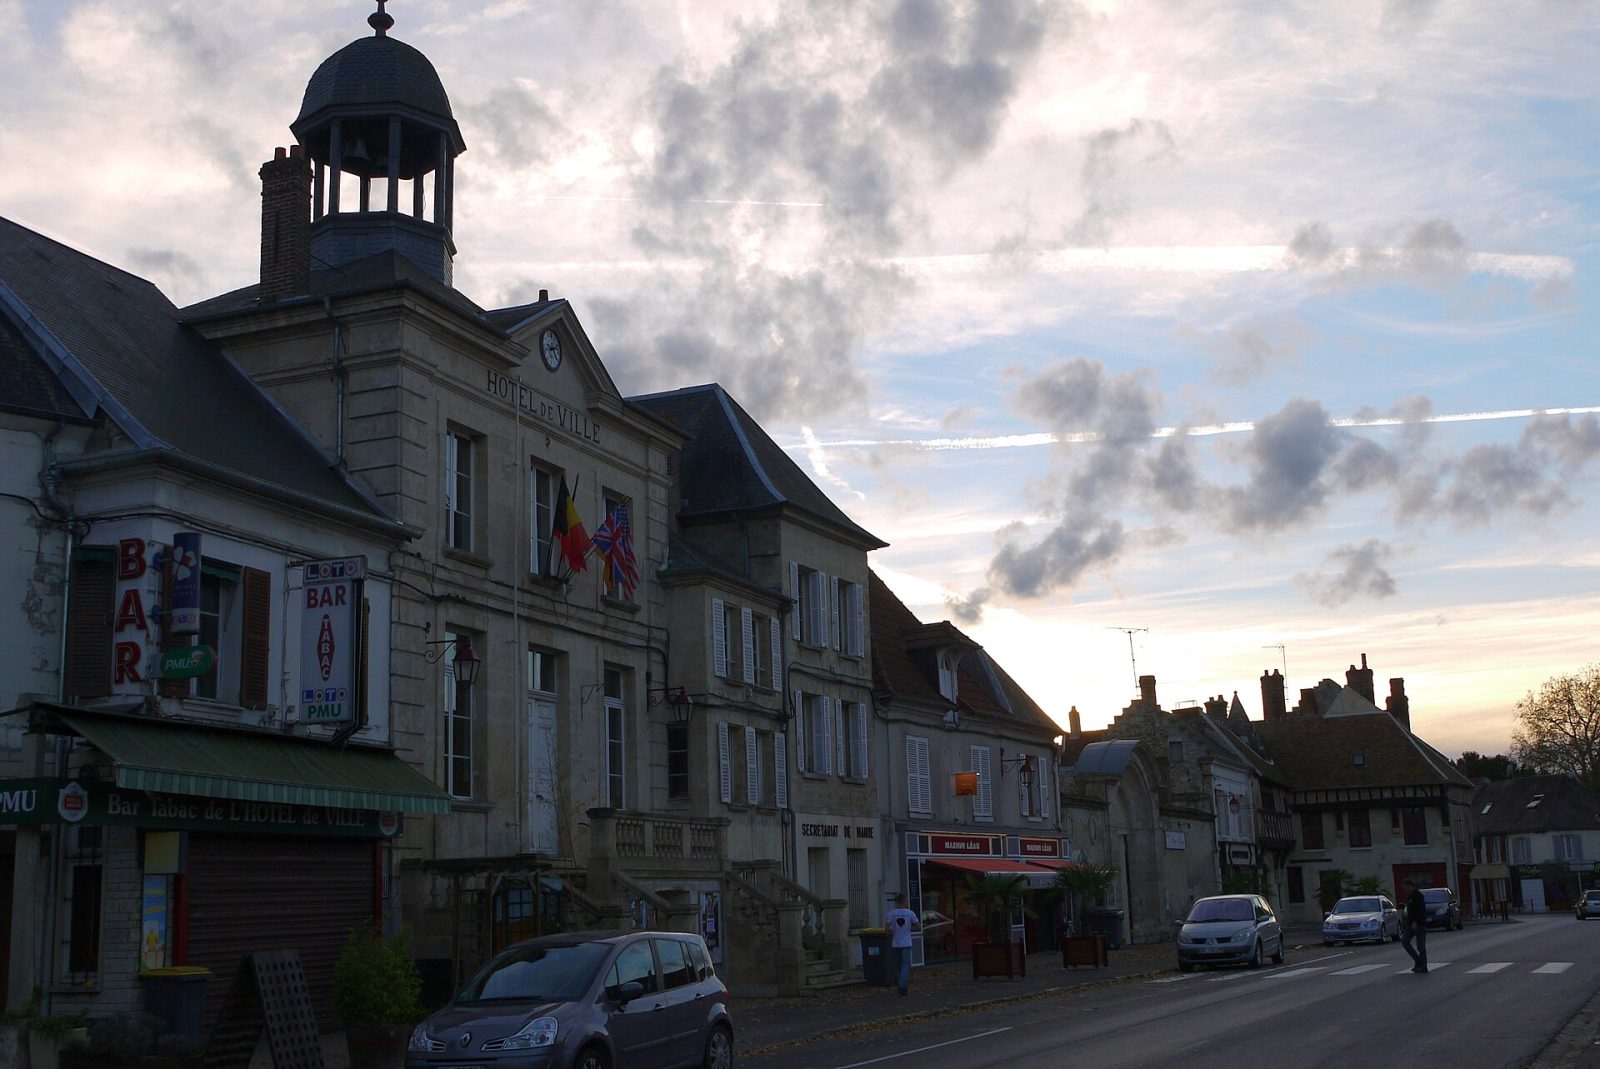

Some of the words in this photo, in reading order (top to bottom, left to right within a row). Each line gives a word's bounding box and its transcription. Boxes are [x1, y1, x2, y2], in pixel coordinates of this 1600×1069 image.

[487, 369, 537, 414] HOTEL
[541, 402, 554, 421] DE
[557, 404, 601, 444] VILLE
[306, 561, 357, 579] LOTO
[307, 584, 346, 609] BAR
[114, 537, 147, 684] BAR
[321, 618, 331, 679] TABAC
[164, 656, 191, 671] PMU
[302, 688, 347, 703] LOTO
[308, 703, 342, 719] PMU
[0, 790, 37, 813] MU
[107, 793, 140, 816] Bar
[151, 797, 198, 818] Tabac
[204, 800, 225, 821] de
[303, 808, 320, 825] de
[325, 811, 366, 828] VILLE
[801, 823, 839, 837] SECRETARIAT
[843, 825, 852, 838] DE
[856, 826, 875, 838] MAIRIE
